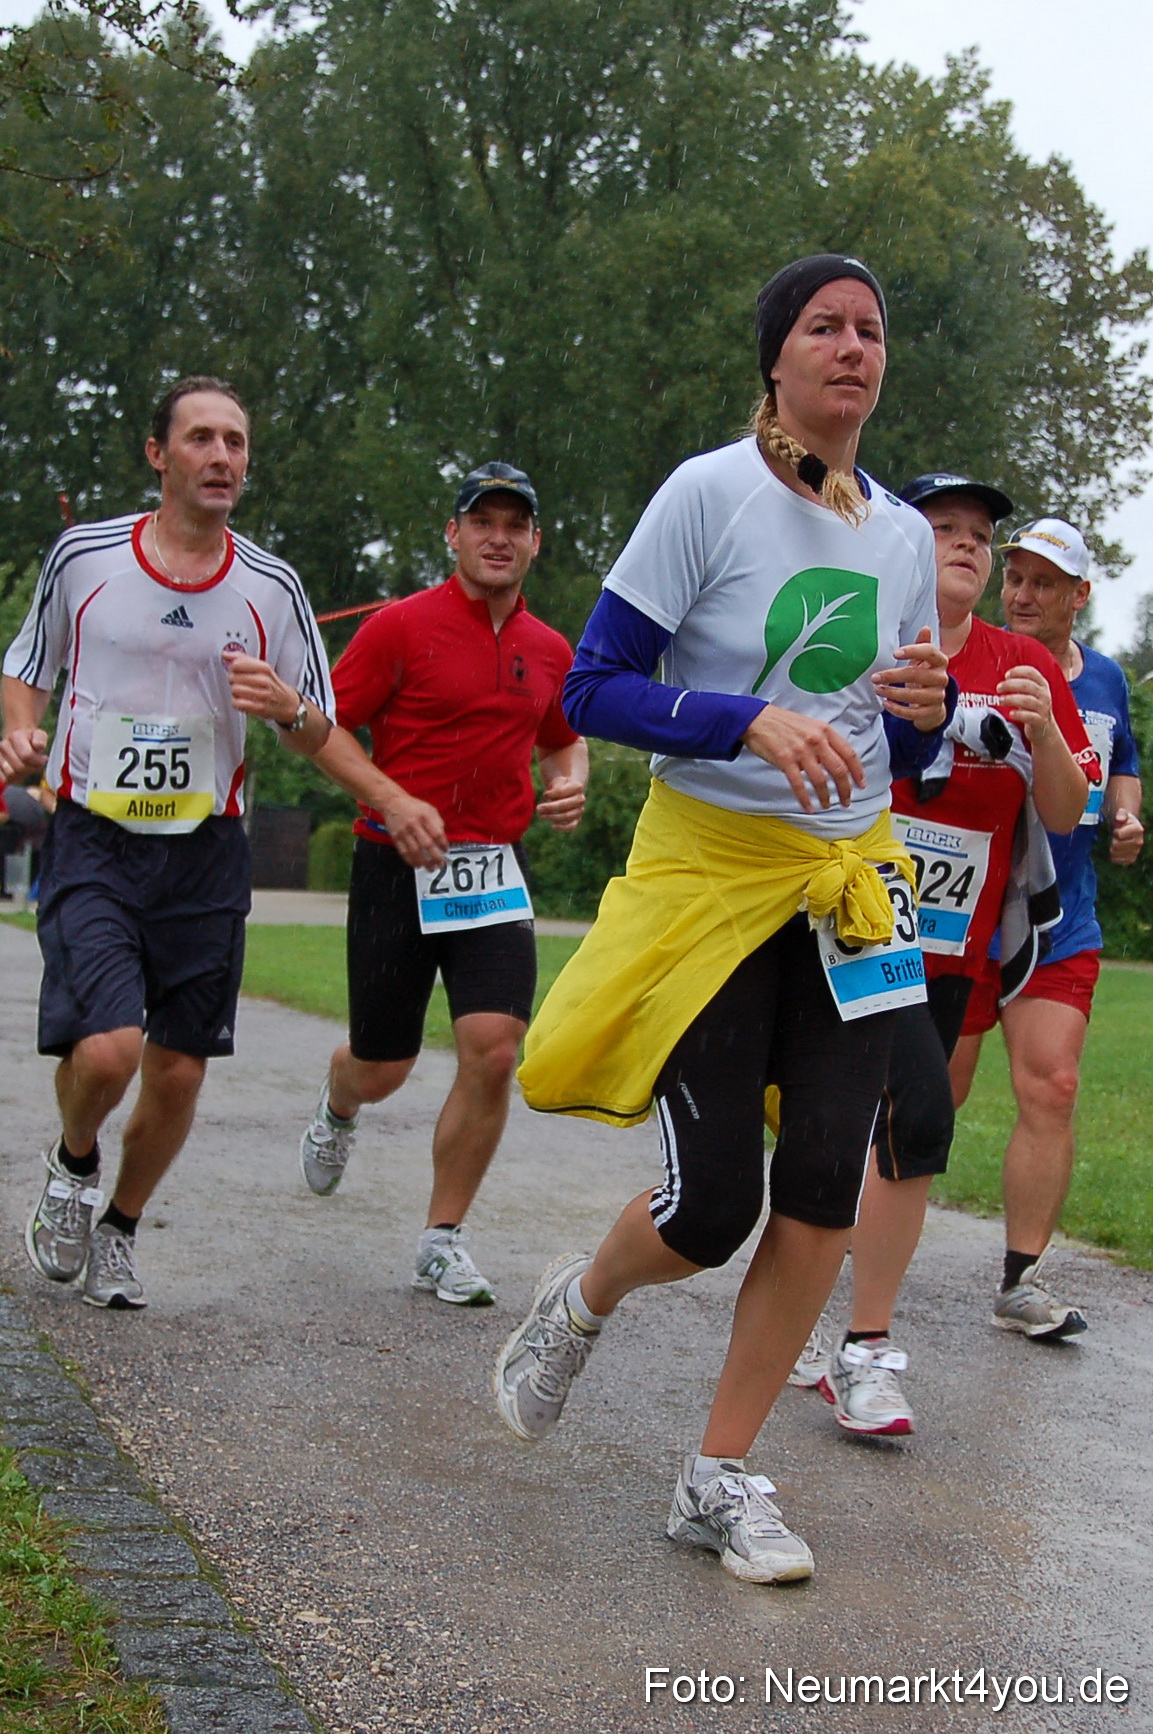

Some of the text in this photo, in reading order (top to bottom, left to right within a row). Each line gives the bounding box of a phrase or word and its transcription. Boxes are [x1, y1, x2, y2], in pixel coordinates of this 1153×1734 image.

[115, 746, 191, 791] 255
[126, 800, 177, 818] Albert
[906, 826, 962, 849] BOCK
[444, 897, 507, 918] Christian
[828, 954, 836, 965] B
[880, 956, 924, 985] Britta
